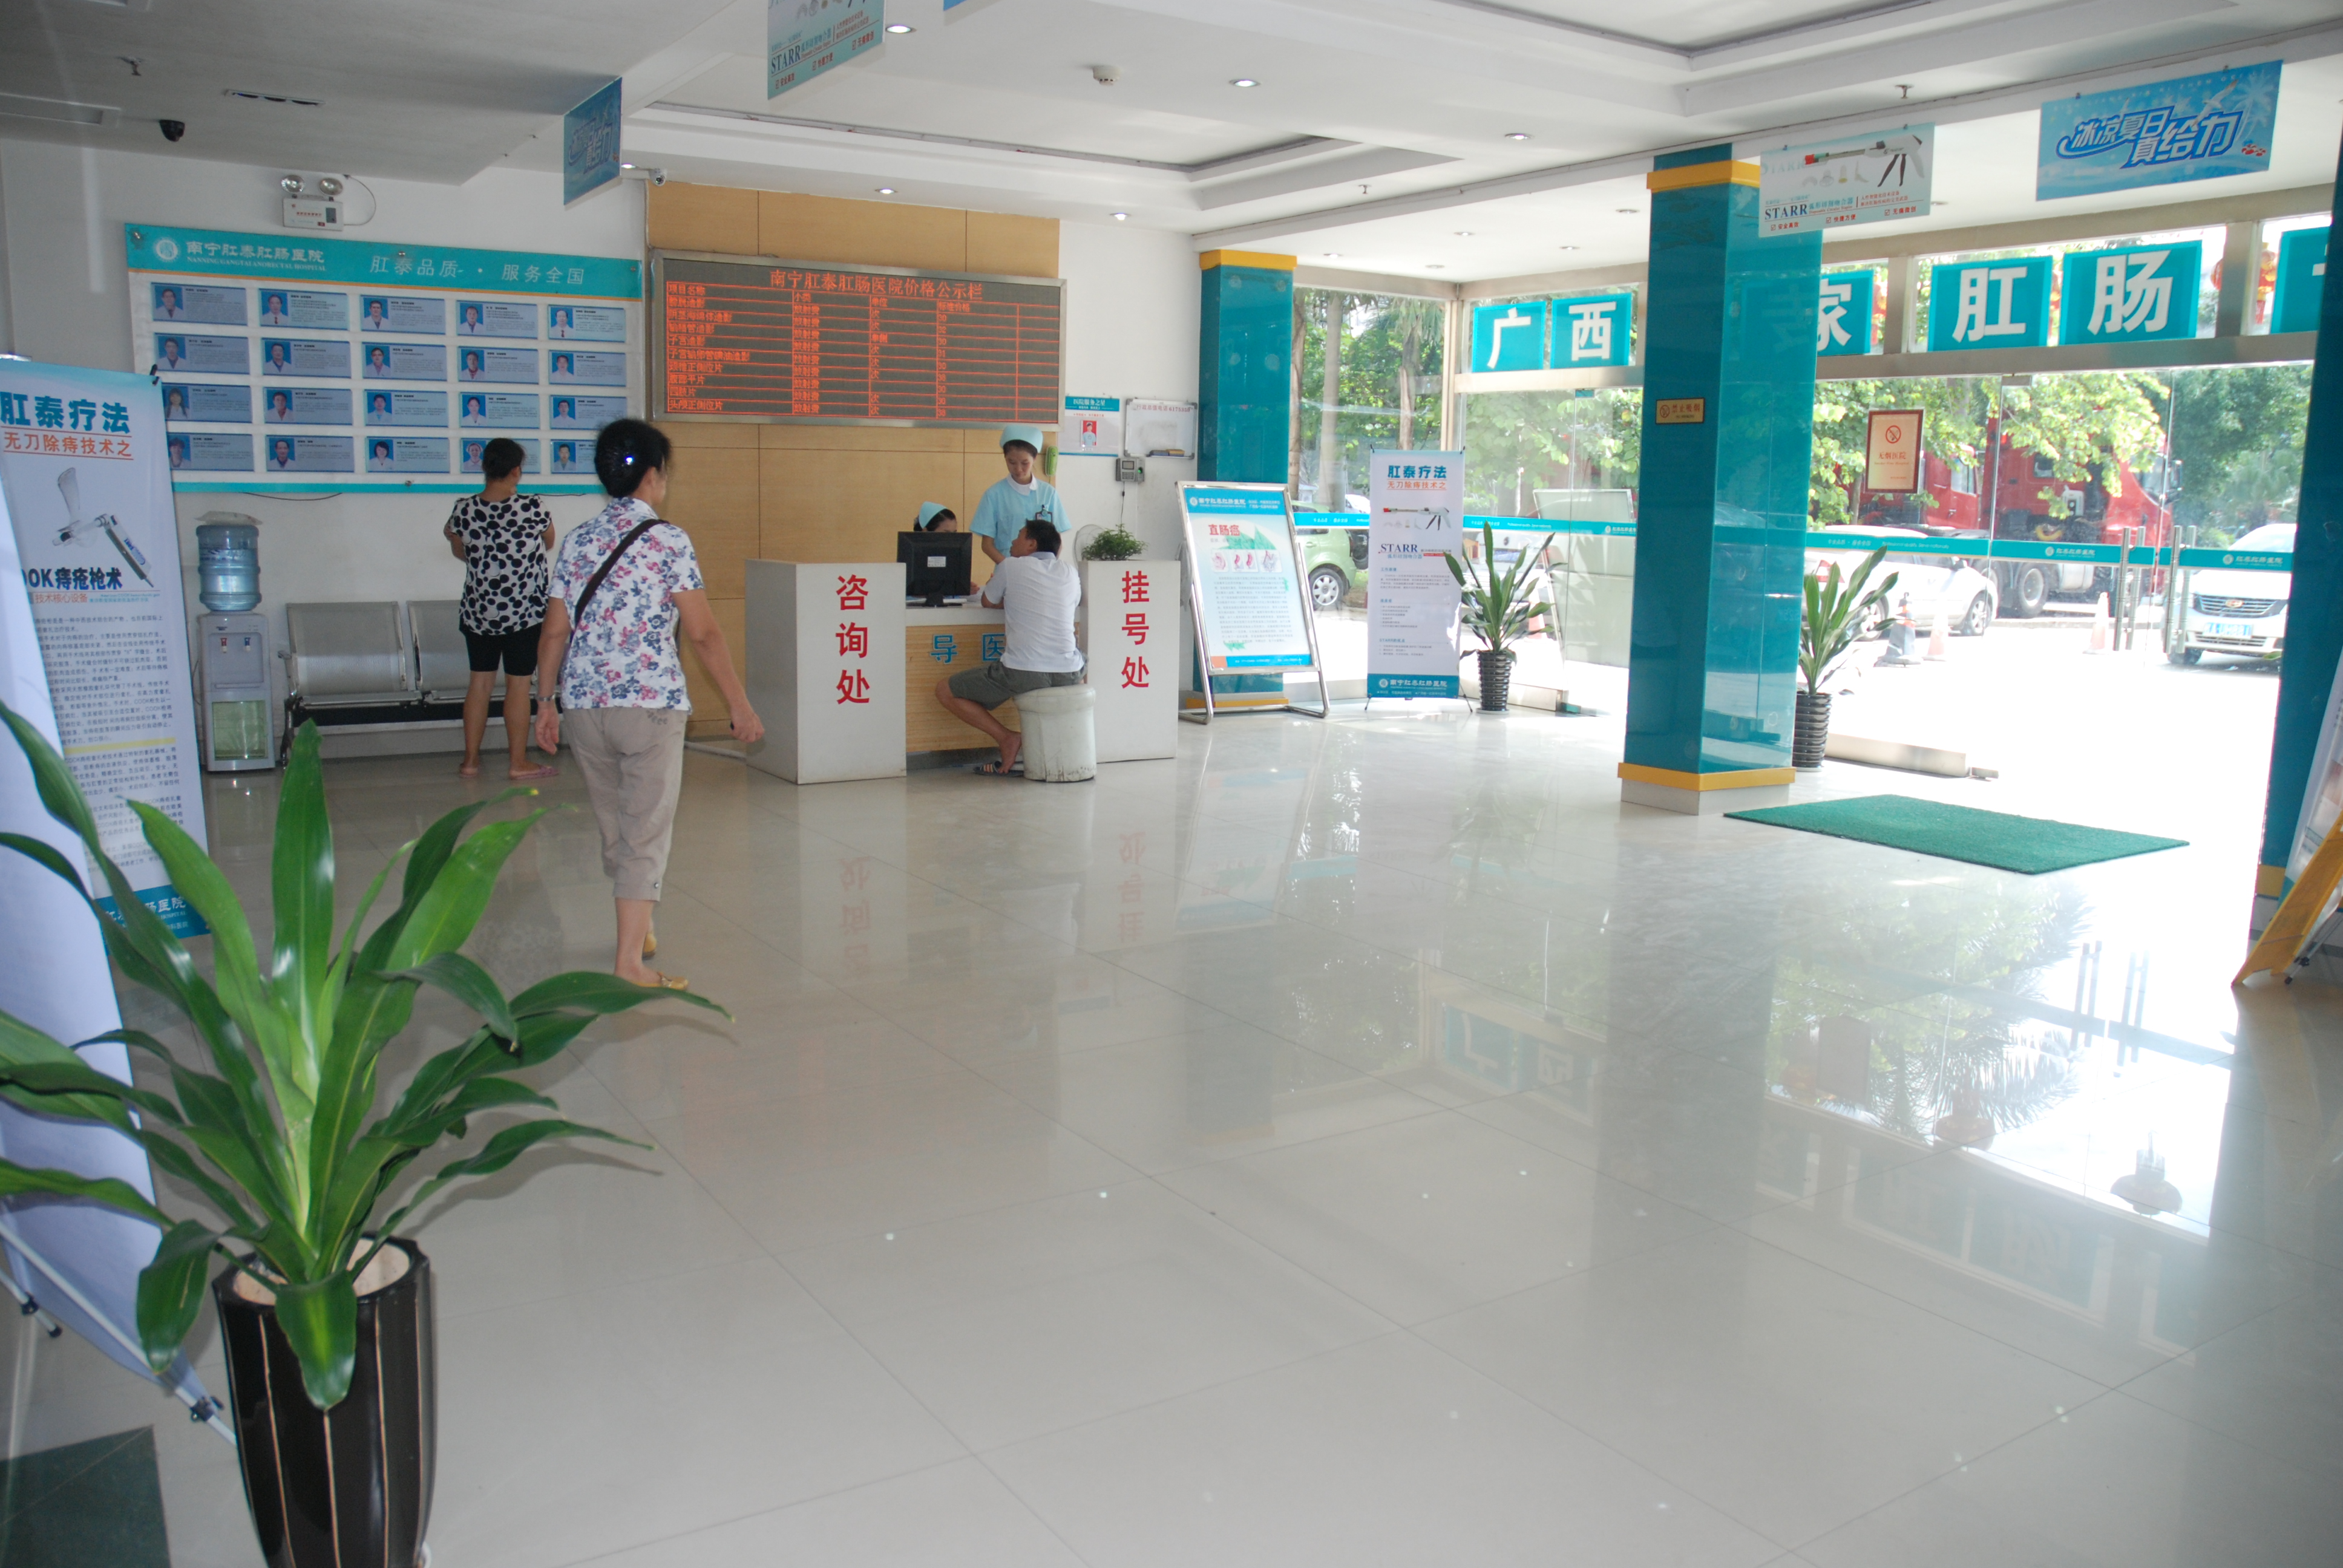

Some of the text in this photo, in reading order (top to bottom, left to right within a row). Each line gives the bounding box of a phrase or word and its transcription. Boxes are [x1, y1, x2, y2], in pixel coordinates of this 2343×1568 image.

[771, 45, 801, 74] STARR
[1765, 204, 1808, 220] STARR
[1834, 214, 1856, 223] 快捷方便
[1893, 206, 1917, 215] 无痛微创
[1778, 221, 1800, 230] 安全高效
[186, 241, 325, 263] 南宁肛泰肛肠医院
[370, 255, 585, 285] 肛泰品质 服务全国
[770, 269, 983, 300] 南宁肛泰肛肠医院价格公示栏
[1486, 301, 1617, 370] 广西
[0, 391, 131, 434] 肛泰疗法
[4, 431, 132, 457] 无刀除痔技术之
[1388, 465, 1447, 479] 肛泰疗法
[1208, 524, 1240, 536] 直肠癌
[1381, 543, 1418, 552] STARR
[34, 593, 88, 604] 技术核心设备
[835, 575, 870, 704] 咨询处
[1121, 570, 1150, 688] 挂号处
